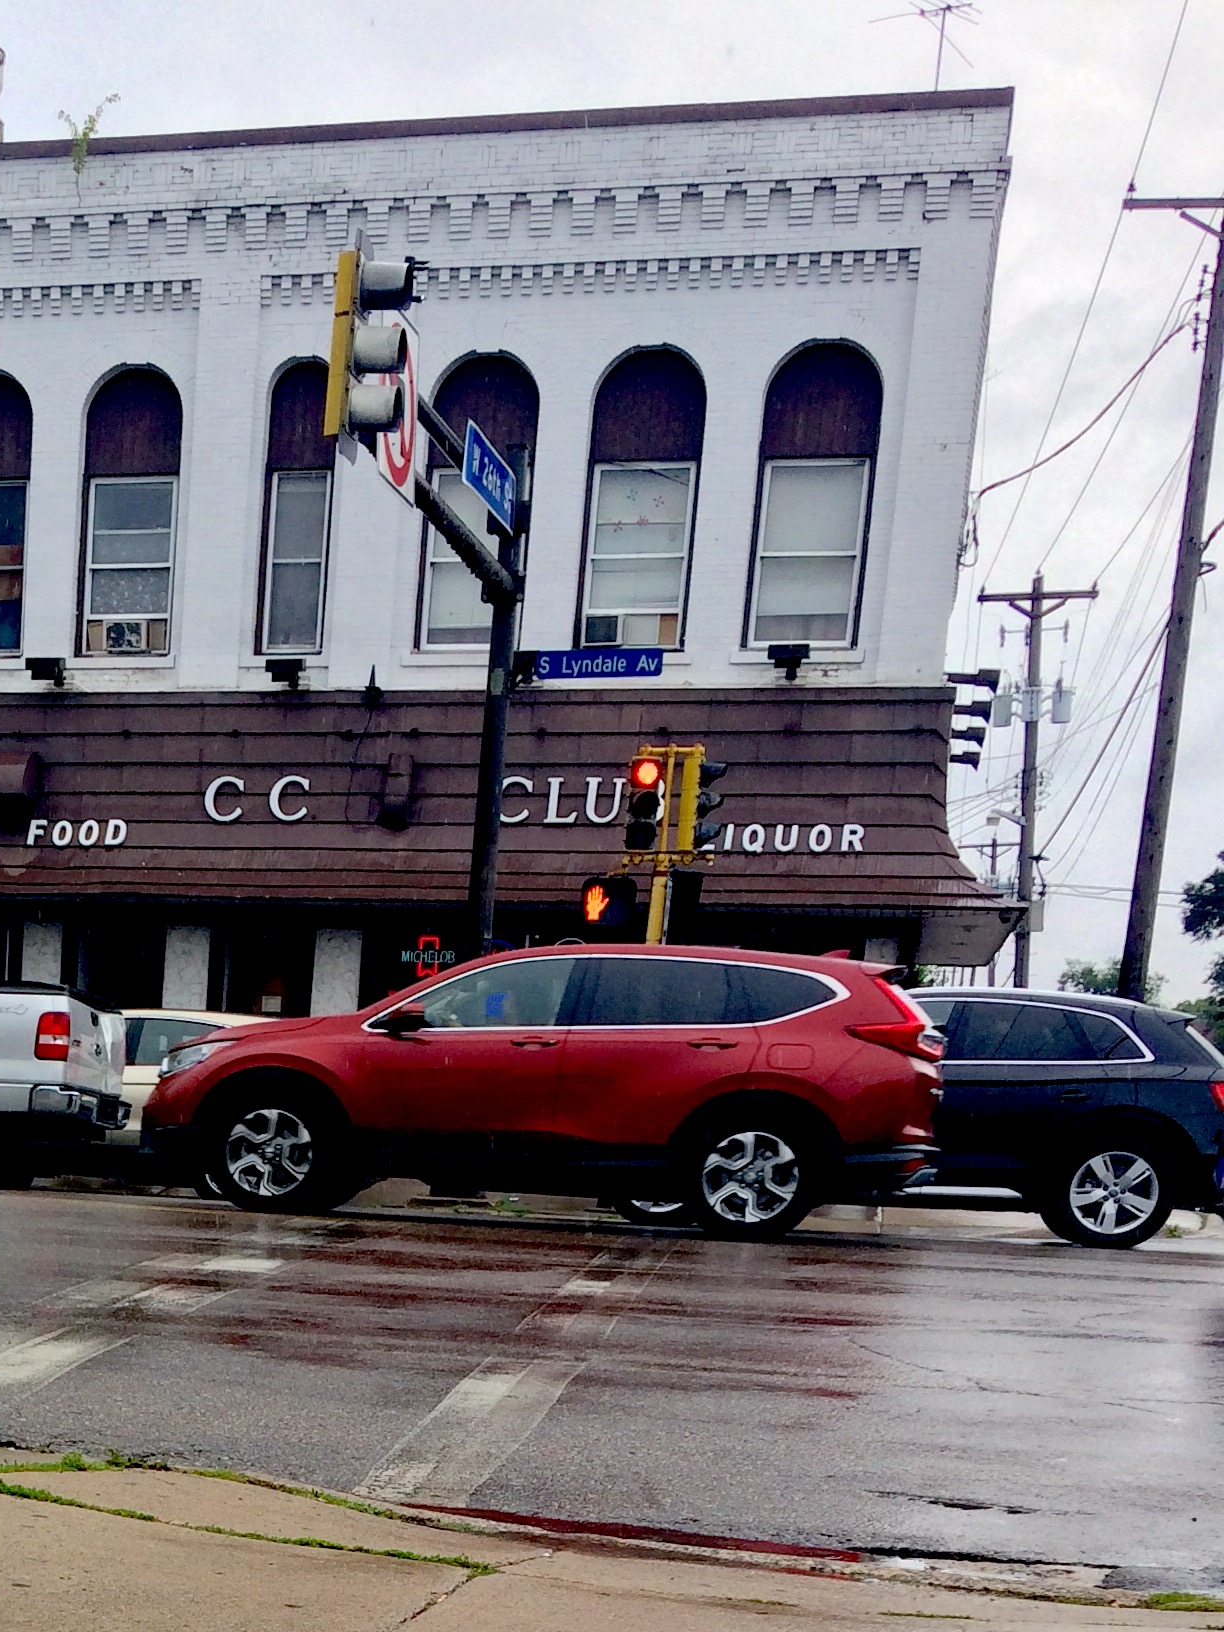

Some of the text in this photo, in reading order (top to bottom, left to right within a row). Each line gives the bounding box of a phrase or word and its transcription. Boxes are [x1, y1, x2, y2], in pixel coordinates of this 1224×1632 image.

[471, 442, 482, 477] W
[482, 456, 501, 503] 26th
[538, 654, 659, 678] S Lyndale Av
[26, 818, 127, 846] FOOD
[400, 950, 456, 963] MICHELOB
